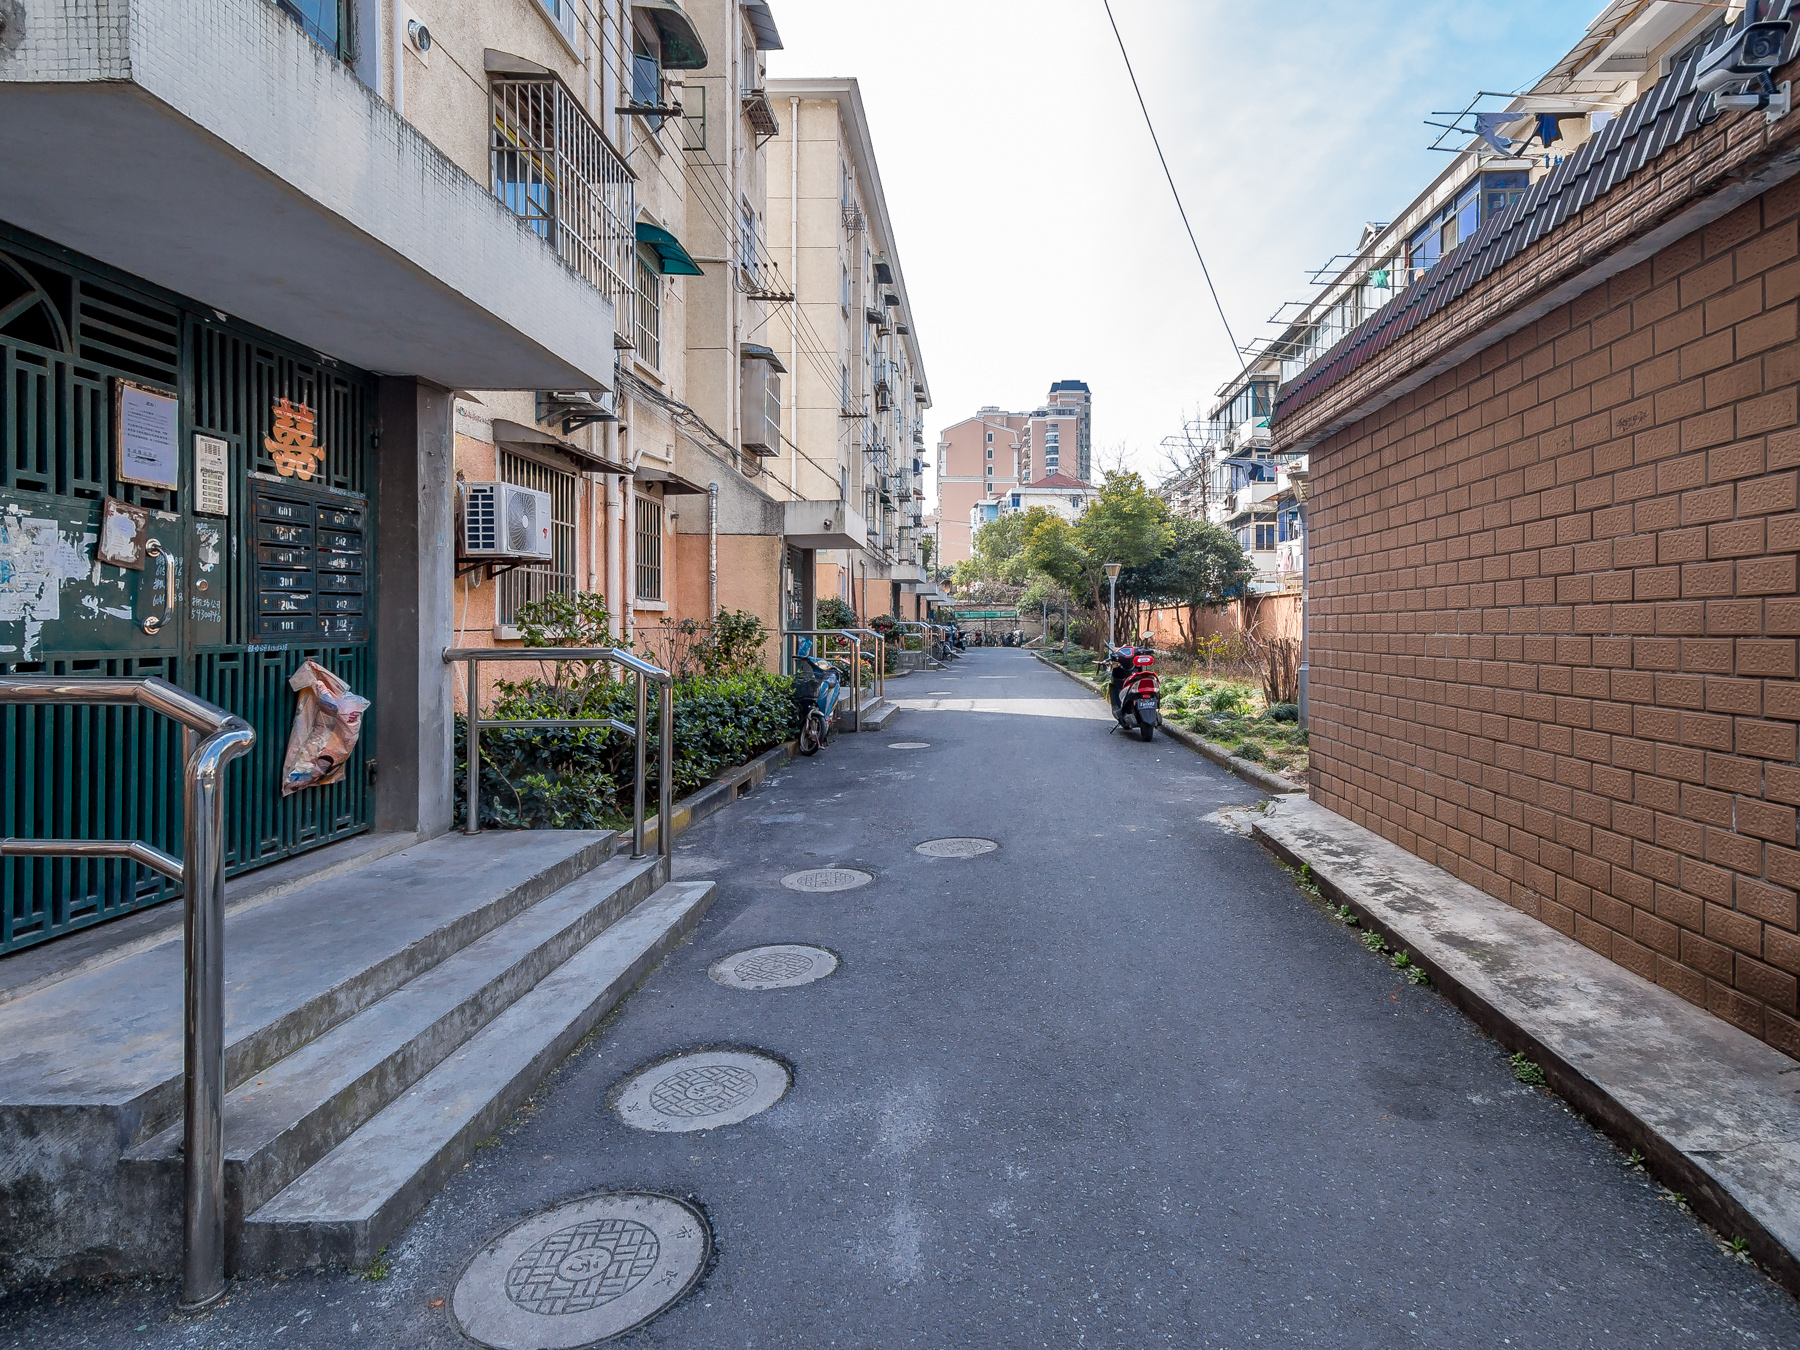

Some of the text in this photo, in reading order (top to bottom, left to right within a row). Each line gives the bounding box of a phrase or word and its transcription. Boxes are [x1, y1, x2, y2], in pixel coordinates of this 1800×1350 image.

[278, 506, 292, 517] 601
[335, 536, 347, 547] 502
[278, 553, 292, 562] 401
[279, 577, 293, 587] 301
[335, 574, 347, 584] 302
[336, 600, 348, 609] 202
[281, 621, 294, 631] 101
[336, 619, 348, 629] 102
